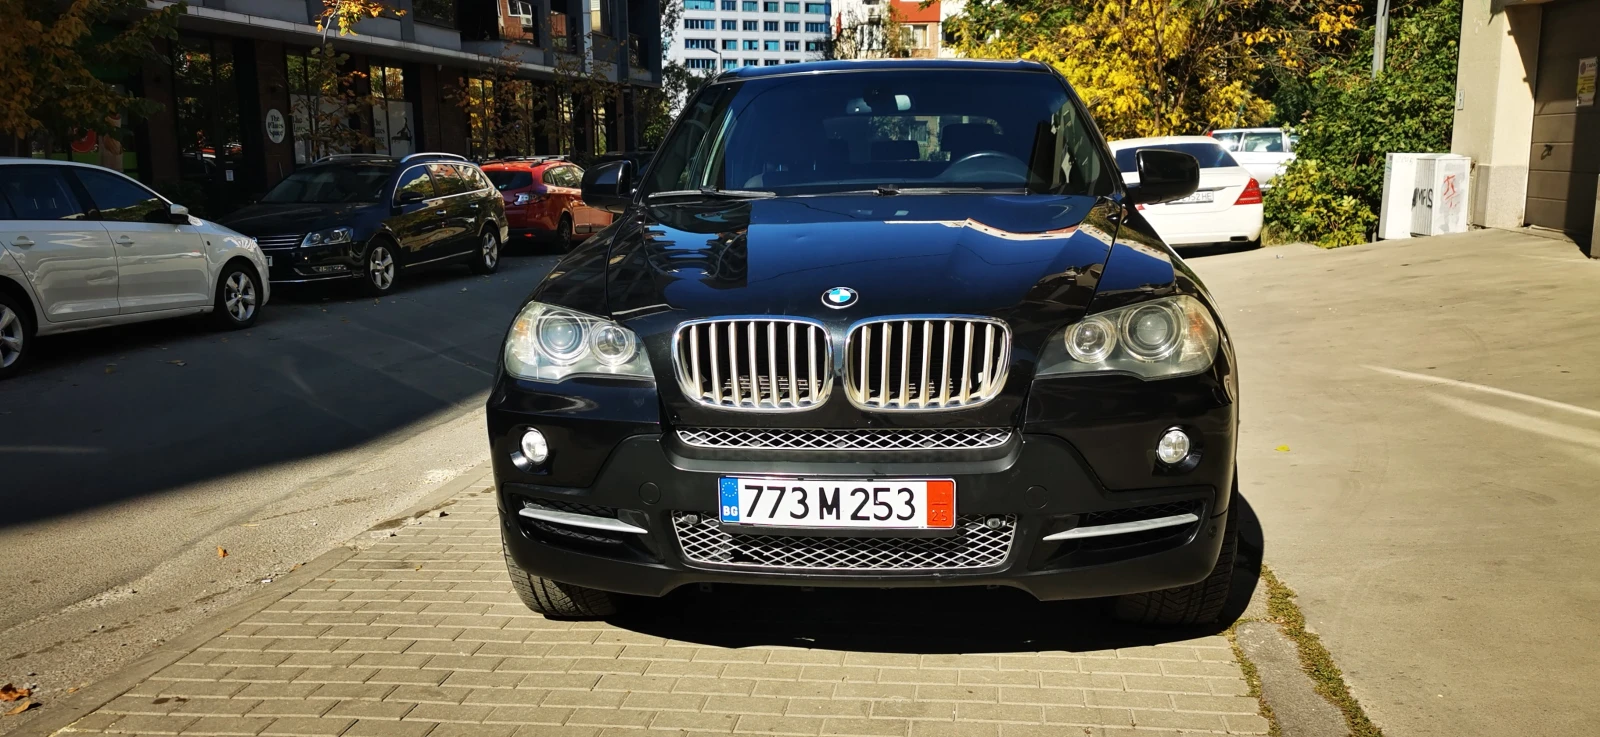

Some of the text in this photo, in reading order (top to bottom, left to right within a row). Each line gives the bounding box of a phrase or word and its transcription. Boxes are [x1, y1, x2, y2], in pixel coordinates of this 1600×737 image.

[270, 114, 280, 122] The
[744, 484, 916, 521] 773 M 253
[723, 505, 738, 517] BG
[931, 509, 948, 522] 25
